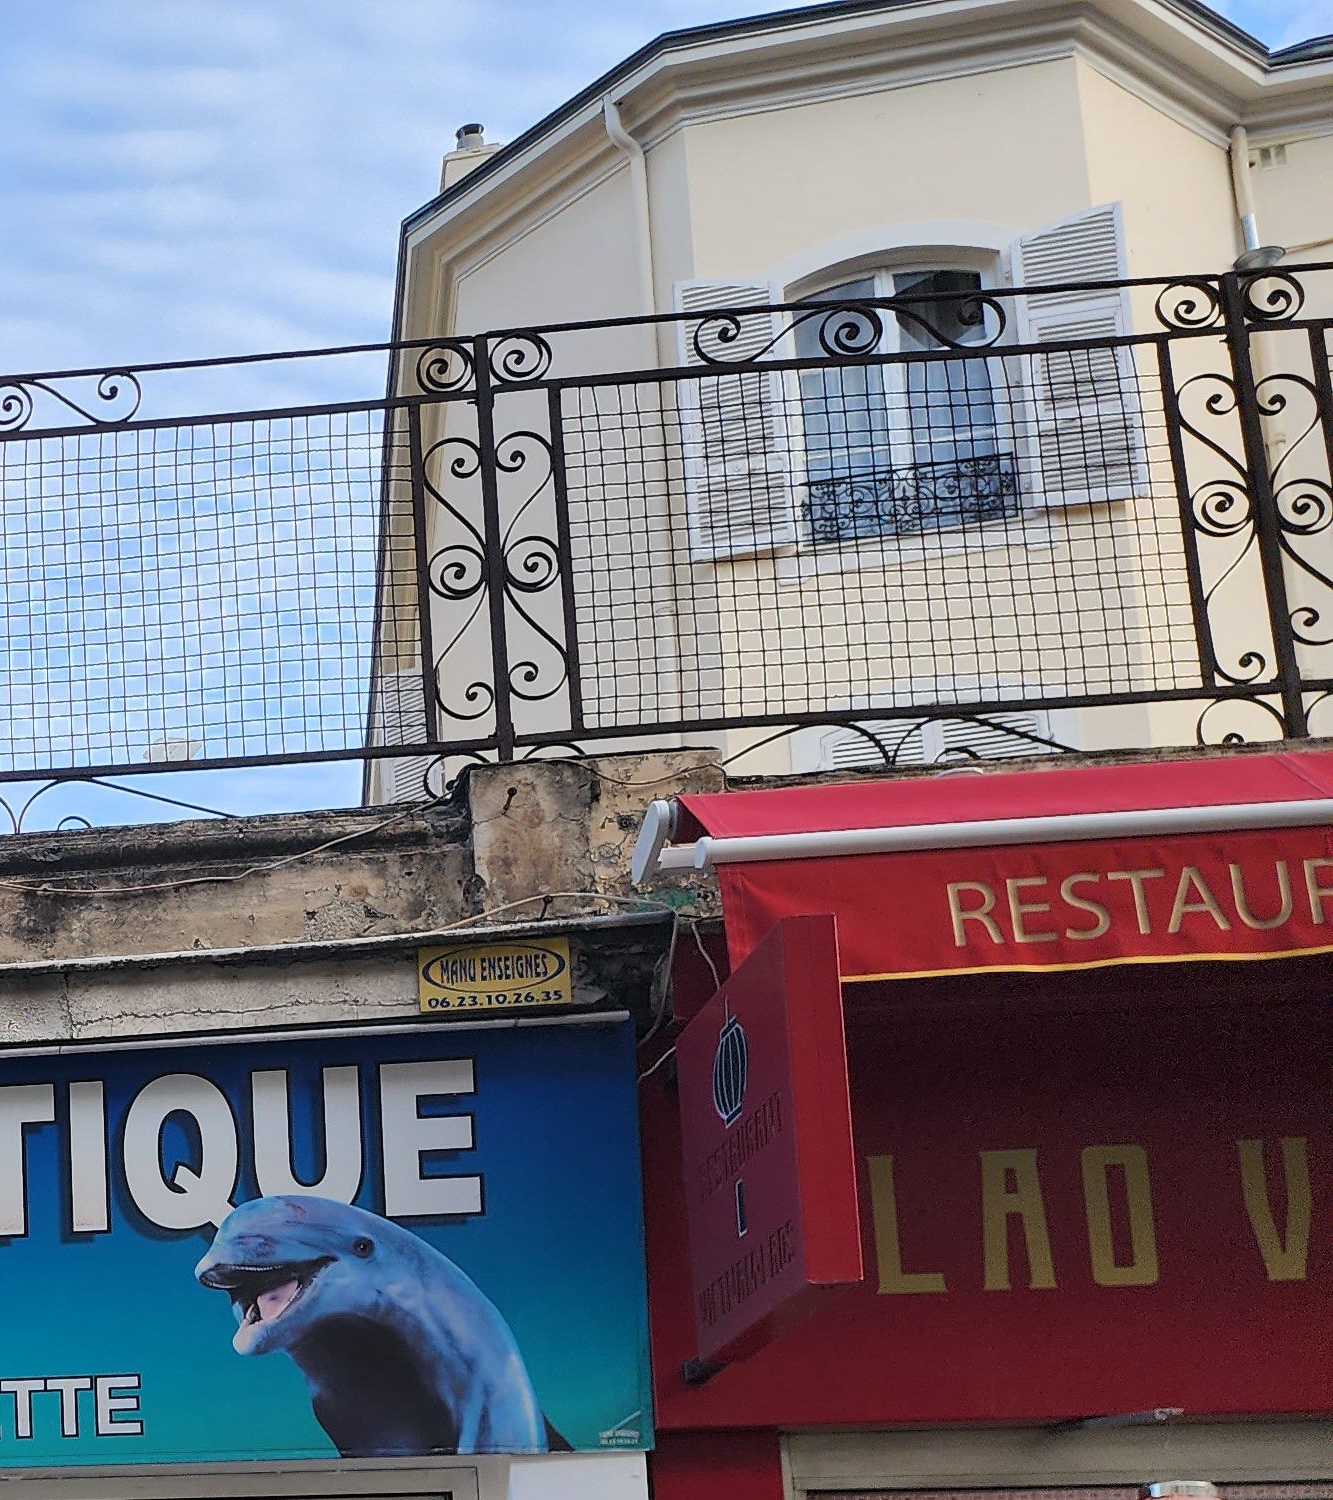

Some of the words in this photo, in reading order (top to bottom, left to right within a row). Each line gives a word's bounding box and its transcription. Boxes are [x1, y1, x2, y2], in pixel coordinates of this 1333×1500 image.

[440, 957, 476, 986] MANU
[480, 953, 549, 982] ENSEIGNES
[427, 989, 563, 1009] 06.23.10.26.35
[866, 1143, 1160, 1295] LAO
[1235, 1136, 1313, 1282] V
